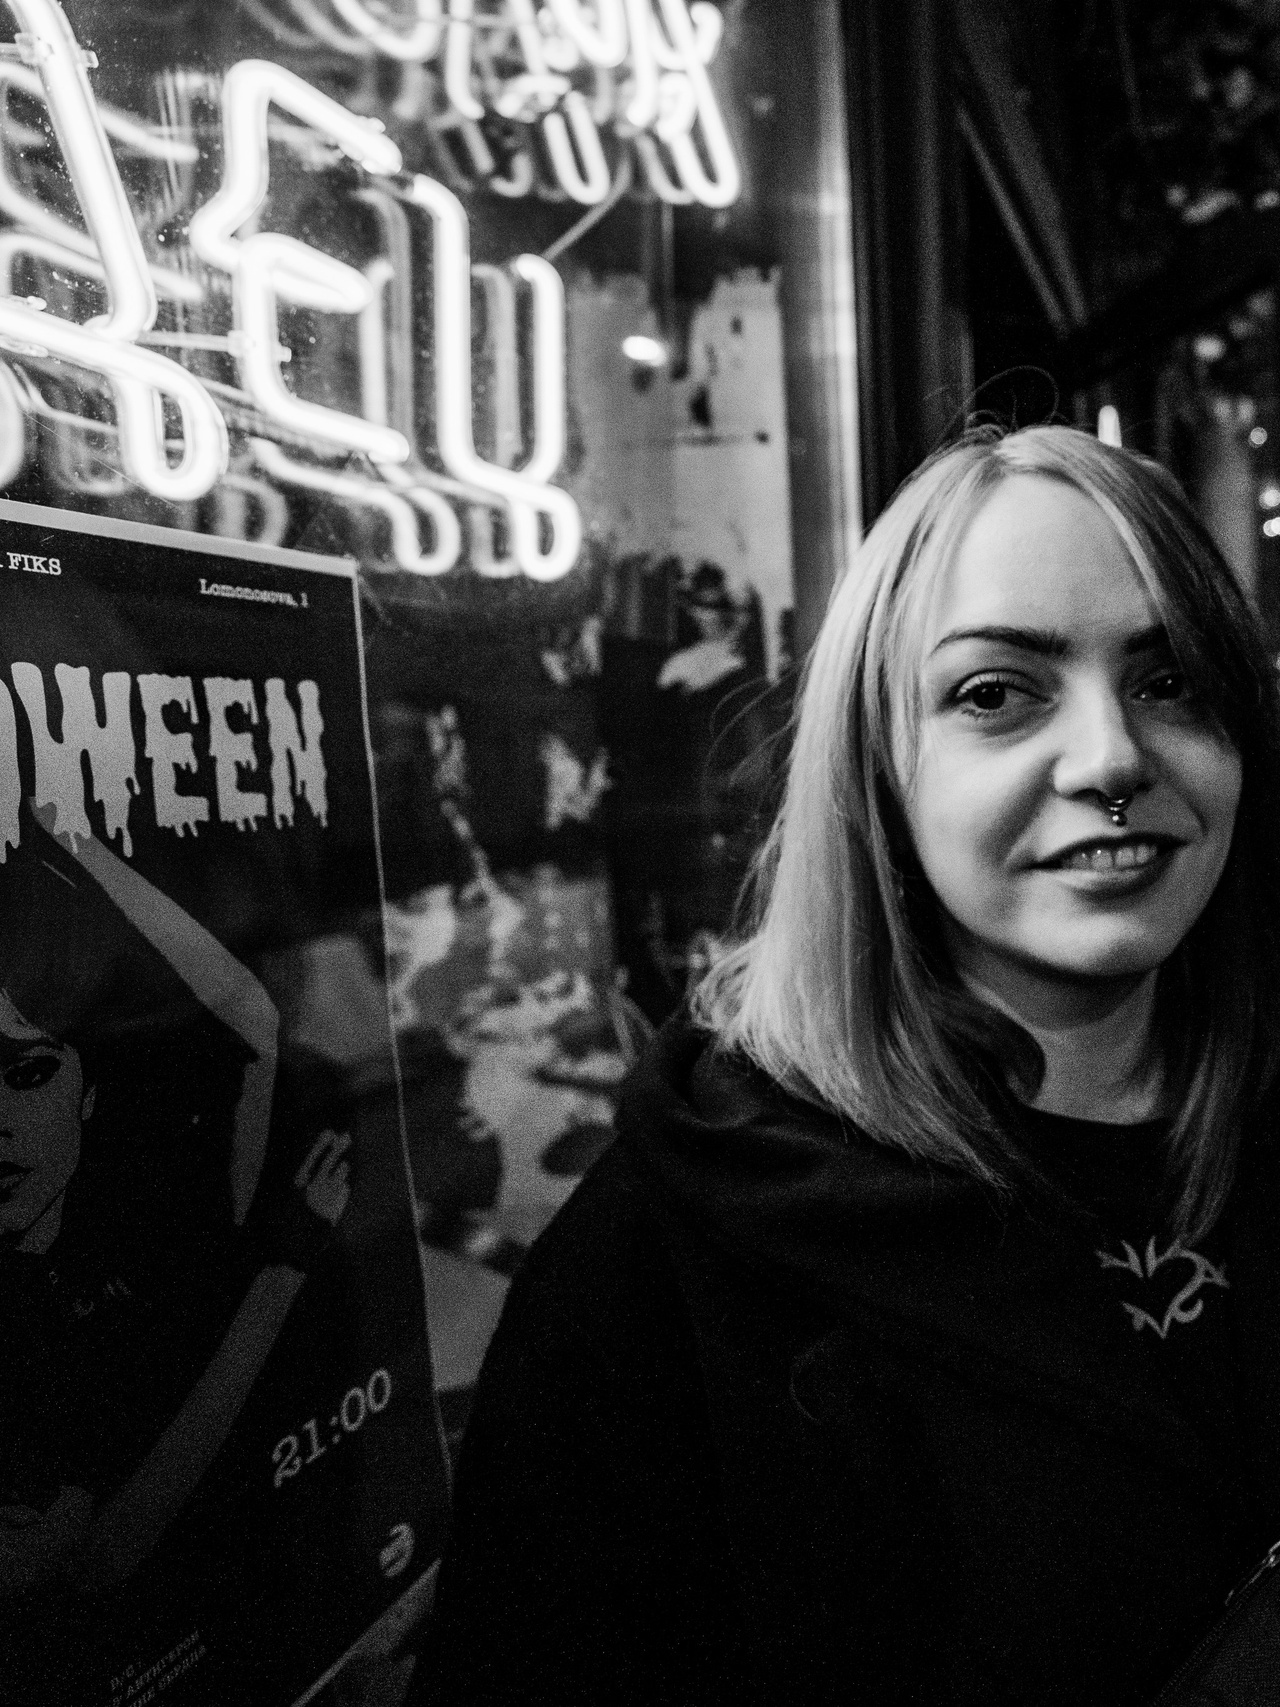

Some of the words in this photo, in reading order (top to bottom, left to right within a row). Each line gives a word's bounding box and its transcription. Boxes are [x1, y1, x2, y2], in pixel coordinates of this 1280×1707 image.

[7, 552, 62, 575] FIKS
[300, 592, 310, 609] 1
[271, 1368, 392, 1488] 21:00
